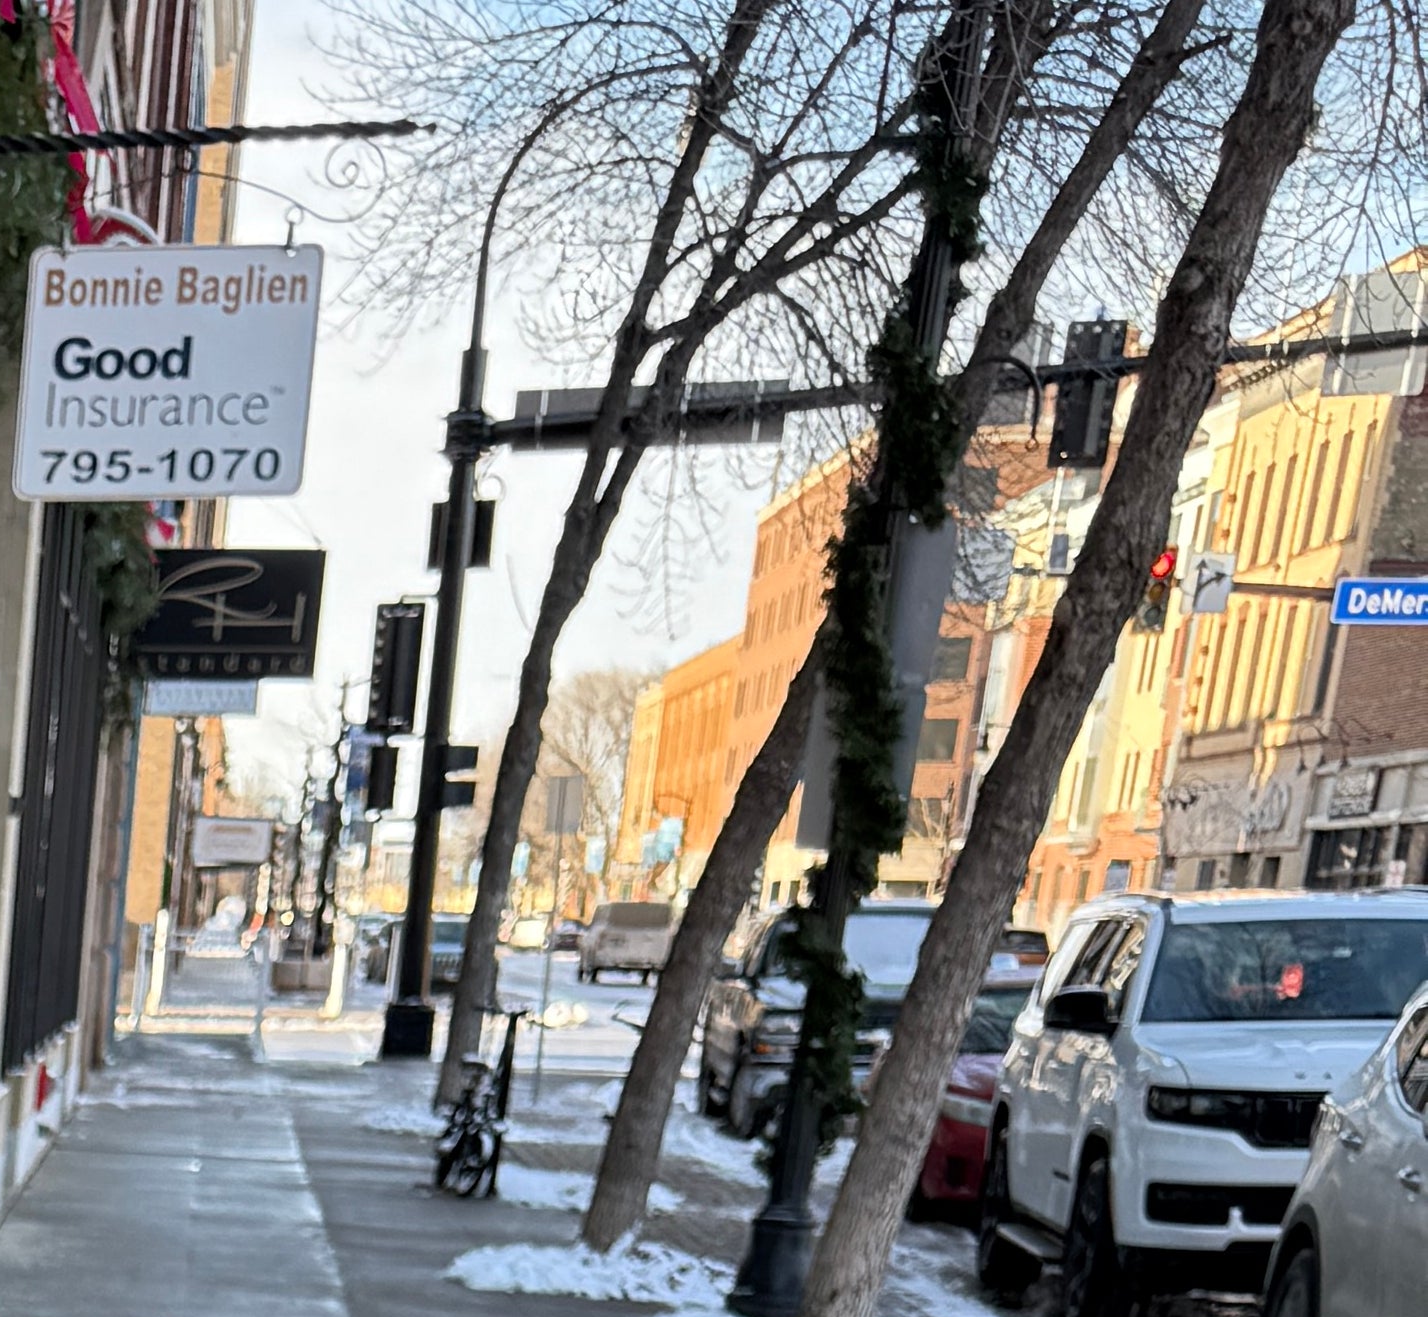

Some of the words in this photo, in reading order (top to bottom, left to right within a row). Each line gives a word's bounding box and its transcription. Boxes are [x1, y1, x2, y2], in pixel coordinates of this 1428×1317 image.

[44, 266, 163, 307] Bonnie
[176, 264, 308, 315] Baglien
[52, 335, 193, 381] Good
[40, 448, 280, 485] 795-1070
[1347, 587, 1428, 615] DeMer
